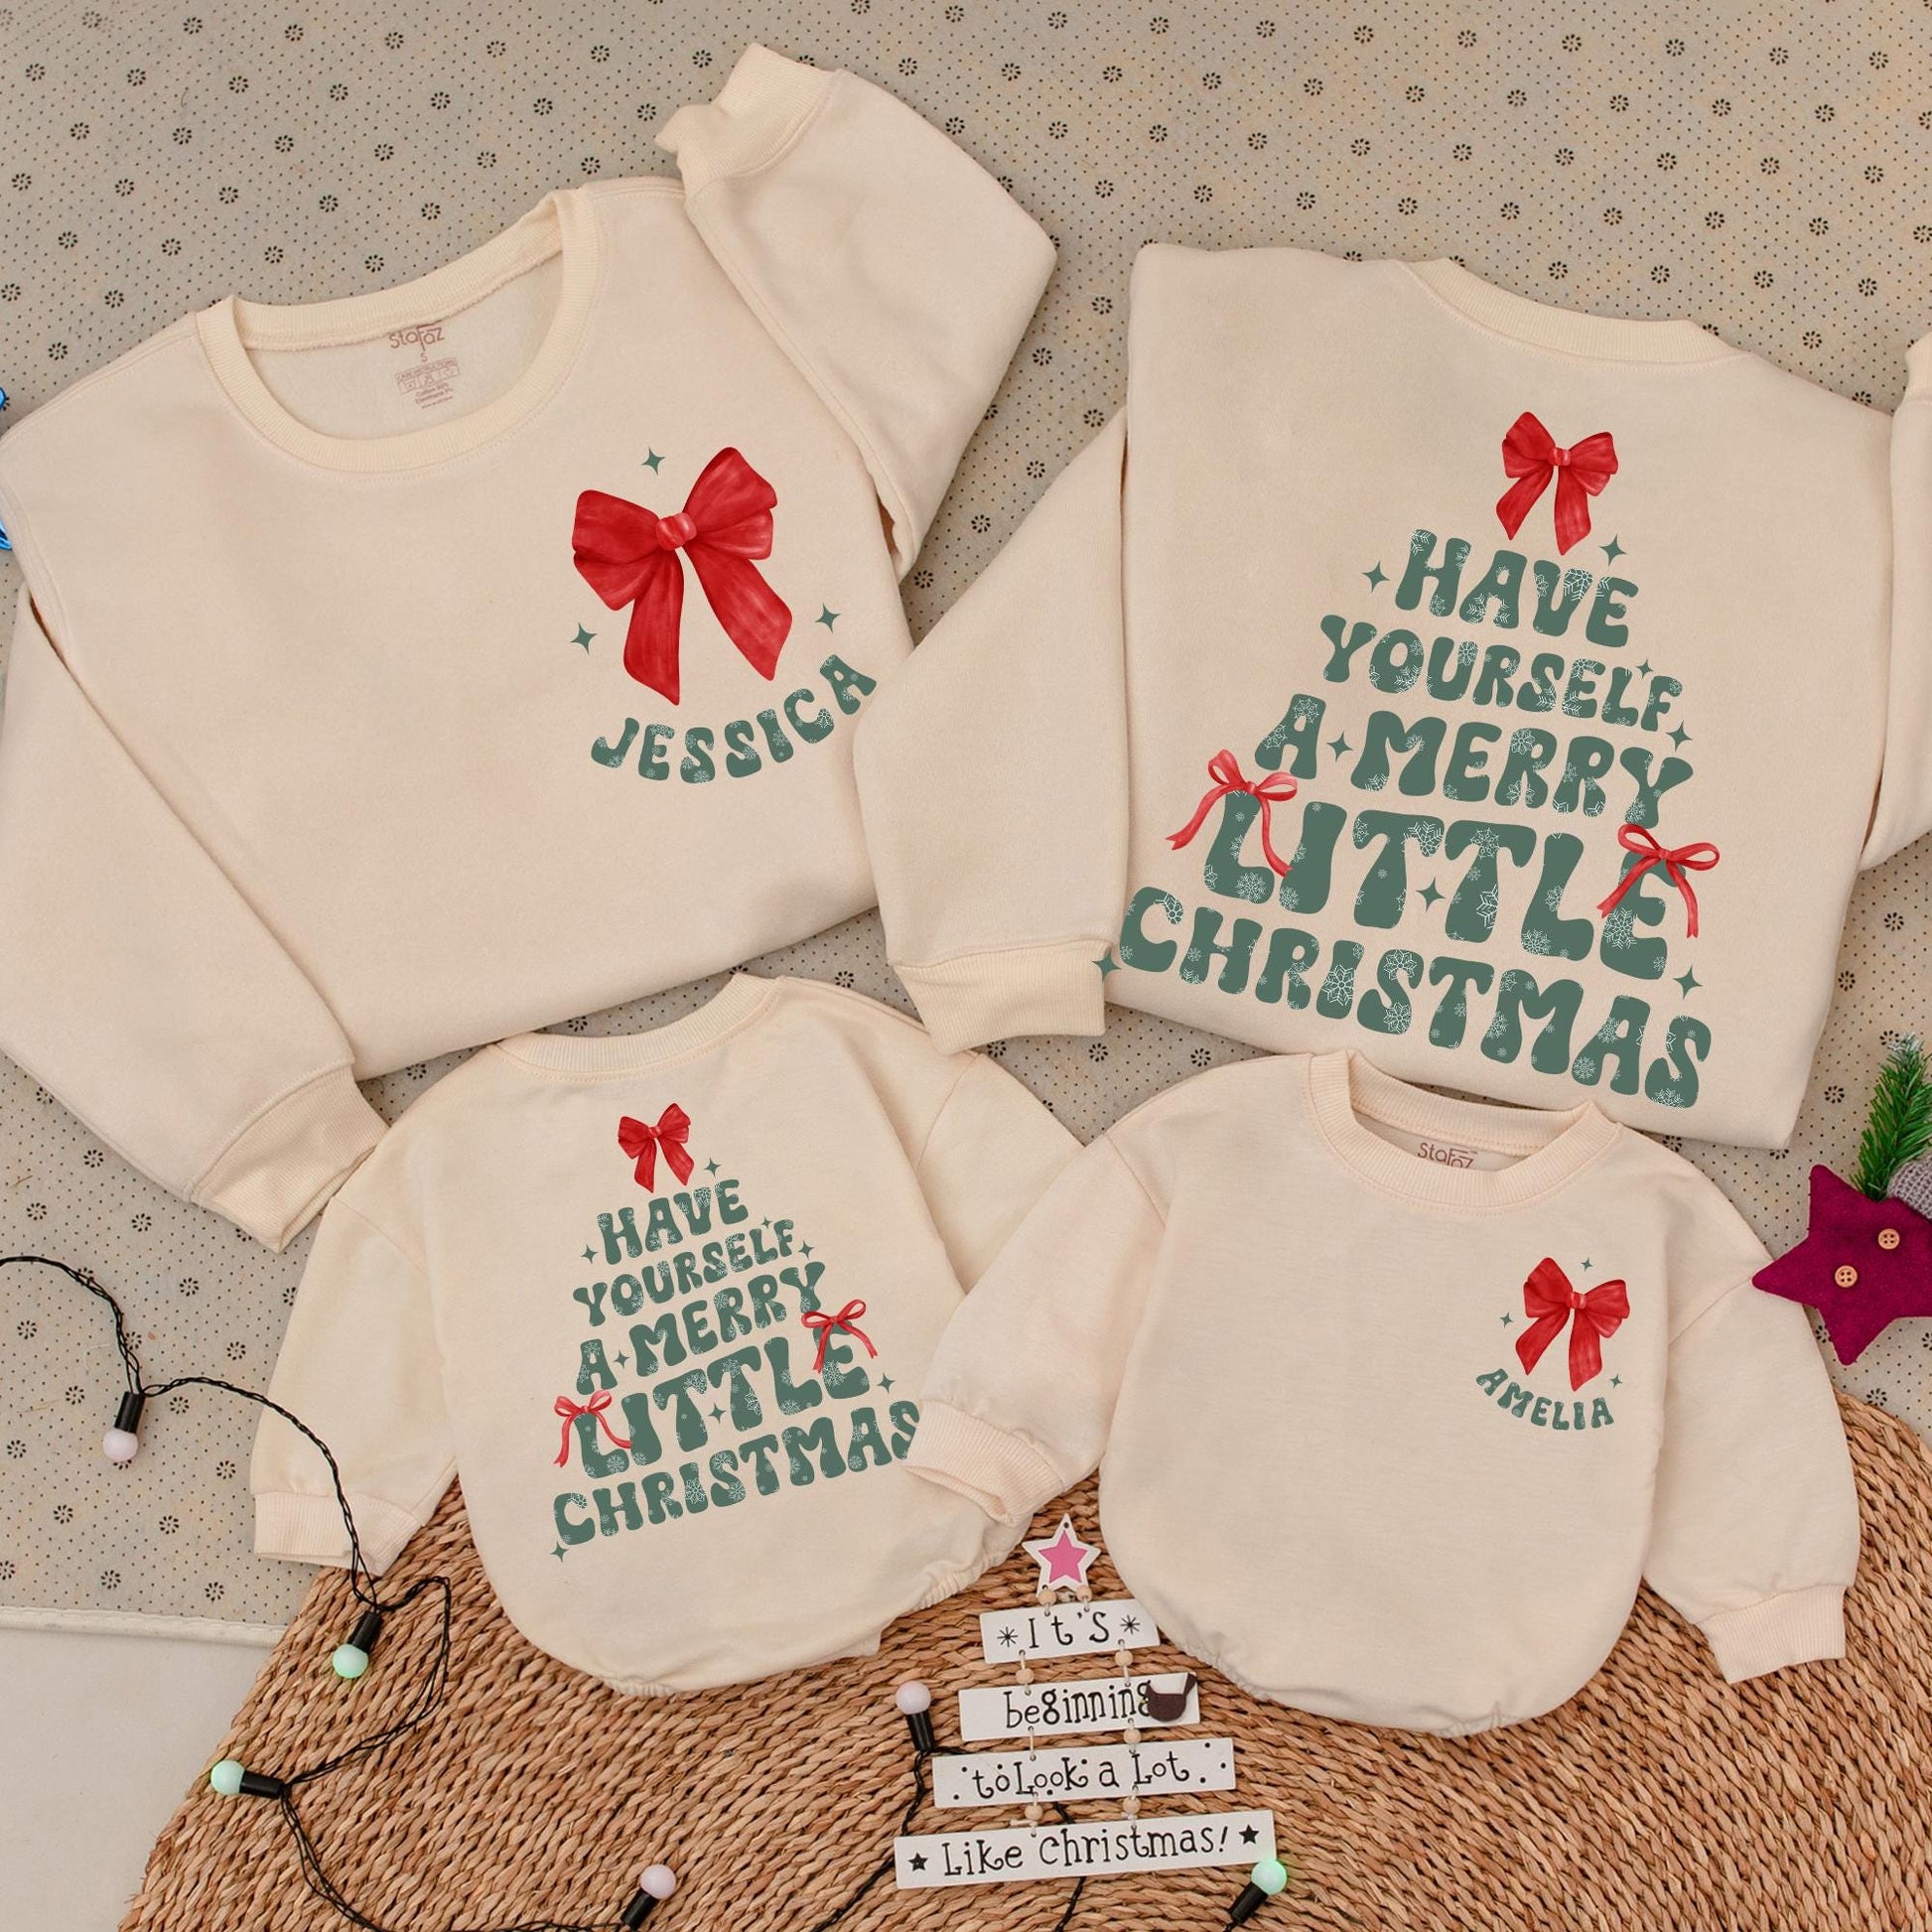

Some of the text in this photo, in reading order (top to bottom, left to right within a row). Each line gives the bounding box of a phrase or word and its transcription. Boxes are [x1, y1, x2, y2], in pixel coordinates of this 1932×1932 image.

[1395, 529, 1639, 648] HAVE
[591, 654, 878, 784] JESSICA
[1320, 615, 1684, 732] YOURSELF
[1255, 694, 1694, 829] A MERRY
[1203, 789, 1688, 981] LITTLE
[1119, 887, 1712, 1109] CHRISTMAS
[572, 1218, 795, 1327] YOURSELF
[596, 1178, 750, 1266] HAVE
[575, 1261, 826, 1396] A MERRY
[573, 1318, 871, 1479] LITTLE
[1475, 1368, 1614, 1431] AMELIA
[552, 1400, 920, 1546] CHRISTMAS
[1098, 1760, 1120, 1787] a
[941, 1839, 1025, 1876] Like
